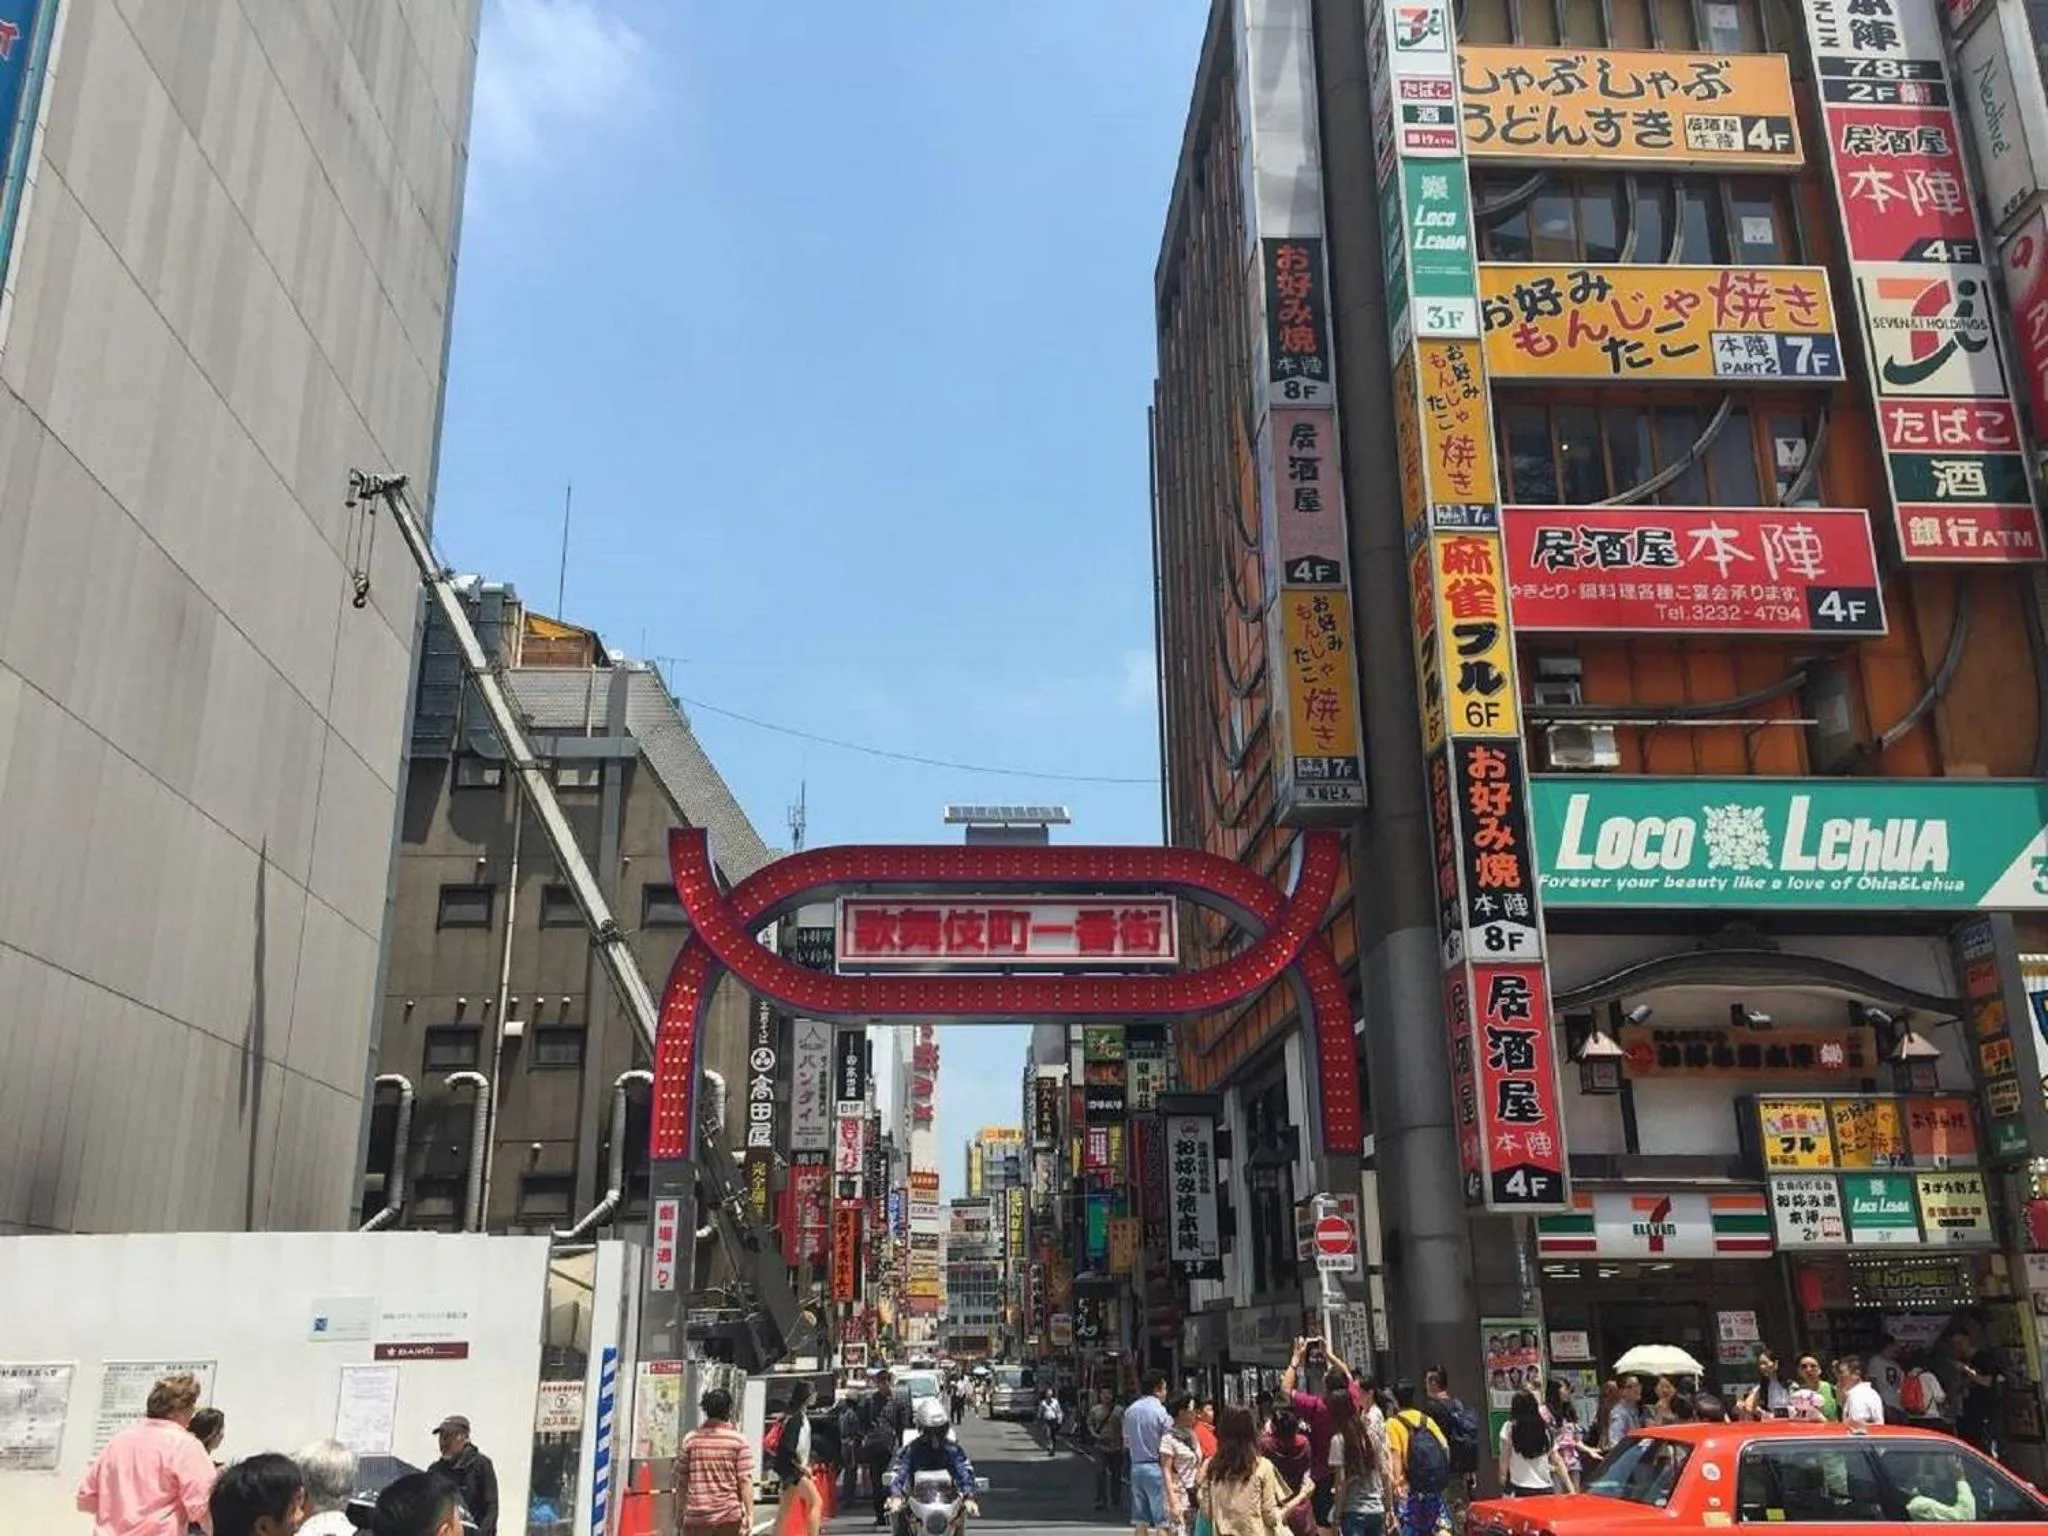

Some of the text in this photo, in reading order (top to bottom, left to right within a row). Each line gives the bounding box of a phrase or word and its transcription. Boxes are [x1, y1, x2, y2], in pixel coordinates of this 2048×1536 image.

[1403, 82, 1452, 98] たばこ
[1460, 54, 1731, 101] しゃぶしゃぶ
[1847, 83, 1896, 100] 2F
[1687, 117, 1738, 132] 居酒屋
[1747, 121, 1791, 150] 4F
[1841, 124, 1951, 157] 居酒屋
[1847, 163, 1962, 217] 本陣
[1921, 240, 1973, 263] 4F
[1276, 244, 1317, 353] お好み焼
[1482, 270, 1613, 332] お好み
[1708, 271, 1819, 330] 焼き
[1427, 306, 1465, 330] 3F
[1512, 288, 1700, 358] もんじゃ
[1599, 320, 1700, 374] たこ
[1719, 335, 1770, 358] 本陣
[1783, 336, 1831, 374] 7F
[1283, 380, 1318, 400] 8F
[1446, 345, 1480, 400] お好み
[1426, 395, 1455, 432] たこ
[1888, 406, 2011, 445] たばこ
[1289, 423, 1323, 513] 居酒屋
[1437, 434, 1479, 496] 焼き
[1931, 459, 1988, 498] 酒
[1469, 506, 1491, 523] 7F
[1908, 515, 2034, 548] 銀行ATM
[1531, 519, 1827, 581] 居酒屋 本陣
[1294, 560, 1331, 582] 4F
[1441, 536, 1499, 619] 麻雀
[1817, 590, 1867, 623] 4F
[1465, 702, 1500, 728] 6F
[1467, 745, 1523, 888] お好み焼
[1537, 874, 1611, 890] Forever
[1616, 876, 1659, 891] your
[1663, 875, 1728, 892] beauty
[1733, 875, 1766, 890] like
[1772, 880, 1782, 890] a
[1787, 876, 1825, 890] love
[1830, 876, 1853, 890] of
[1473, 892, 1530, 919] 本陣
[854, 909, 1163, 952] 歌舞伎町一番街
[1484, 925, 1525, 952] 8F
[1483, 974, 1548, 1125] 居酒屋
[748, 1073, 775, 1147] 高田屋
[1494, 1130, 1552, 1159] 本陣
[1505, 1169, 1550, 1198] 4F
[657, 1205, 675, 1283] 劇場通り
